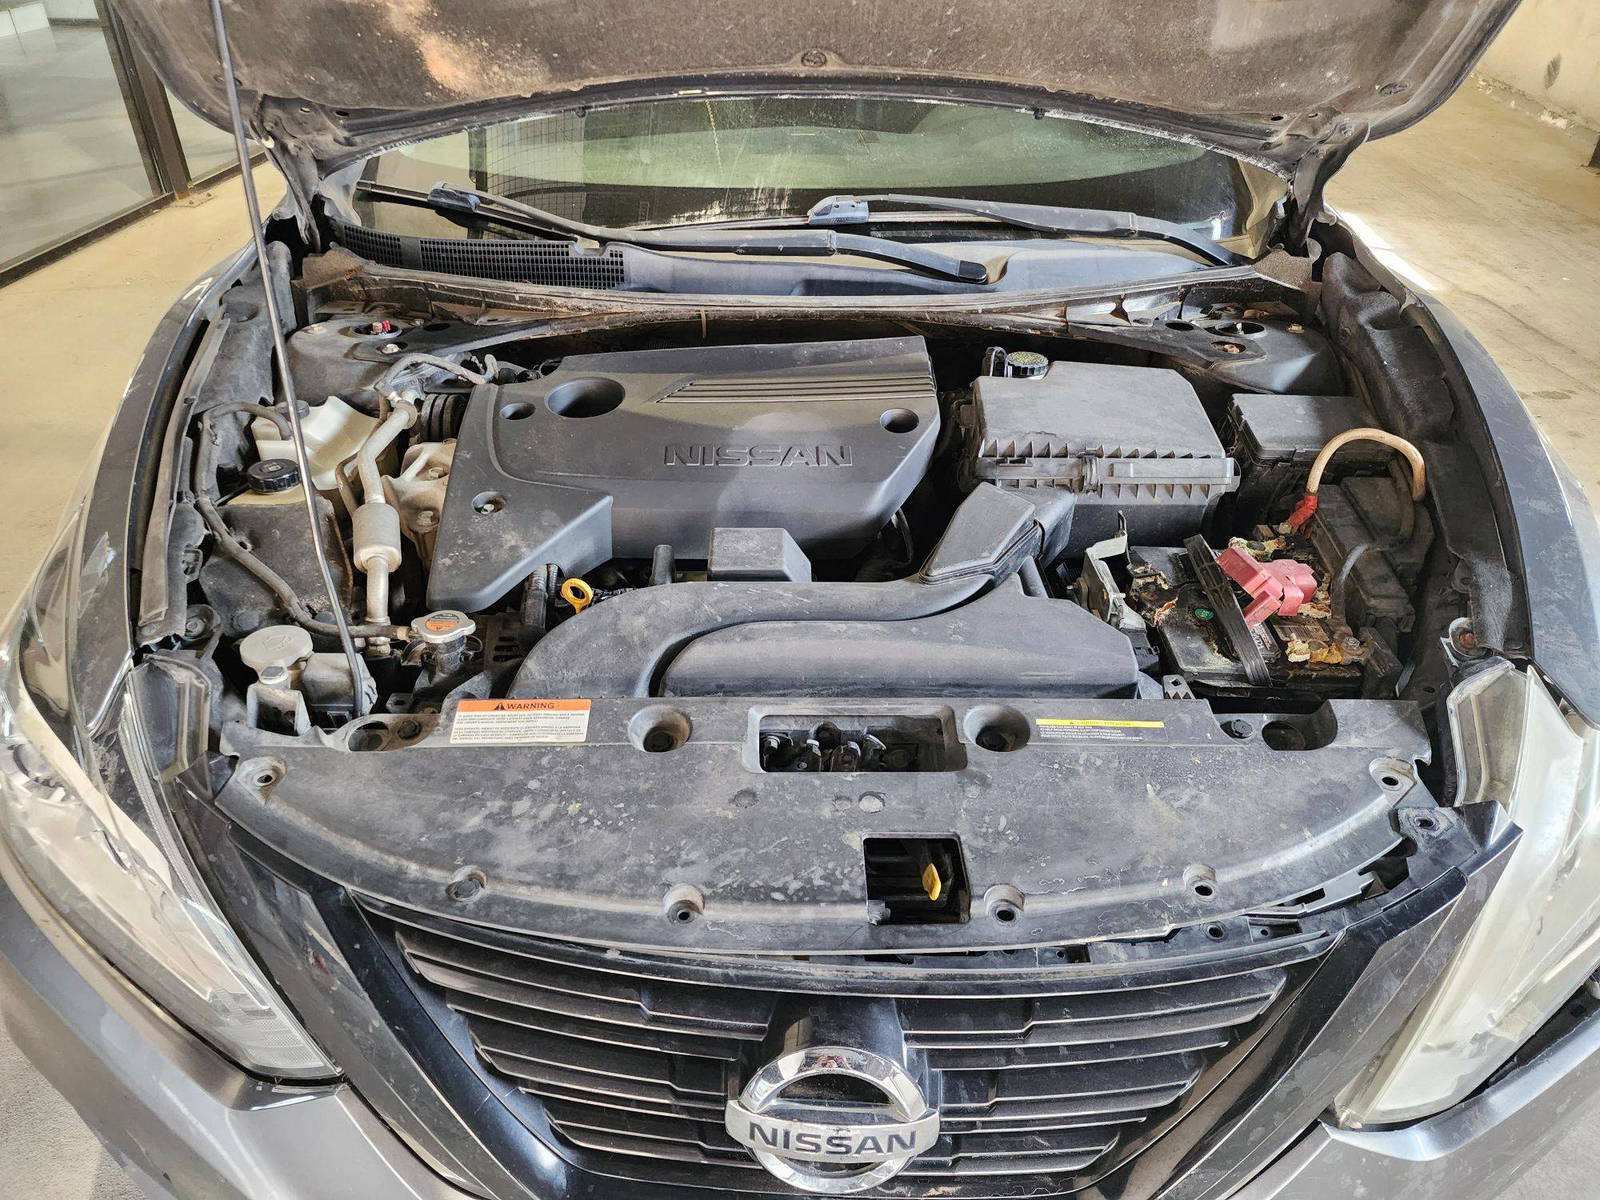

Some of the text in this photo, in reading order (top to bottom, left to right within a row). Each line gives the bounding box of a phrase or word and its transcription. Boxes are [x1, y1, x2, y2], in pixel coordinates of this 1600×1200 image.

[664, 445, 853, 467] NISSAN
[507, 702, 555, 710] WARNING
[750, 1122, 917, 1155] NISSAN
